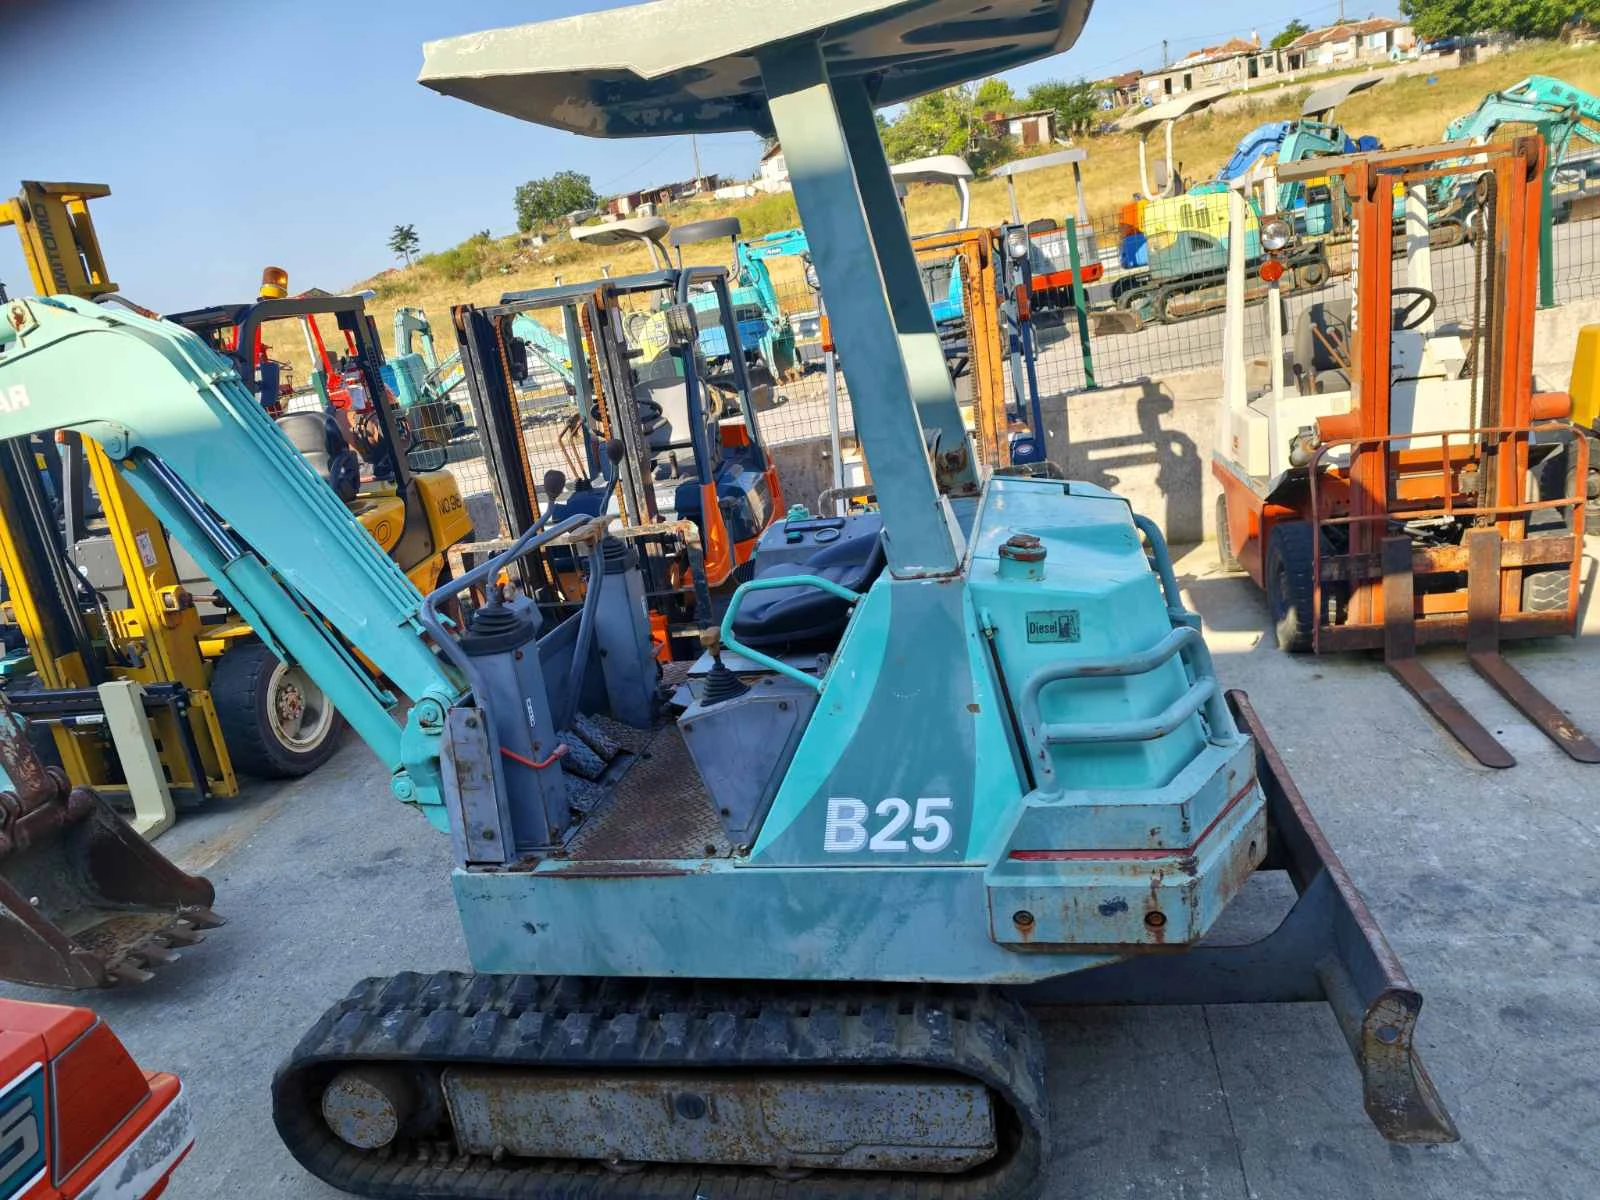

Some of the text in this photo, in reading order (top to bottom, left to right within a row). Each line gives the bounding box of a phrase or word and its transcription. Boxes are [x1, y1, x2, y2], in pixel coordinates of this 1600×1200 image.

[1351, 219, 1360, 331] NISSAN
[1029, 620, 1058, 634] Diesel
[823, 797, 953, 853] B25
